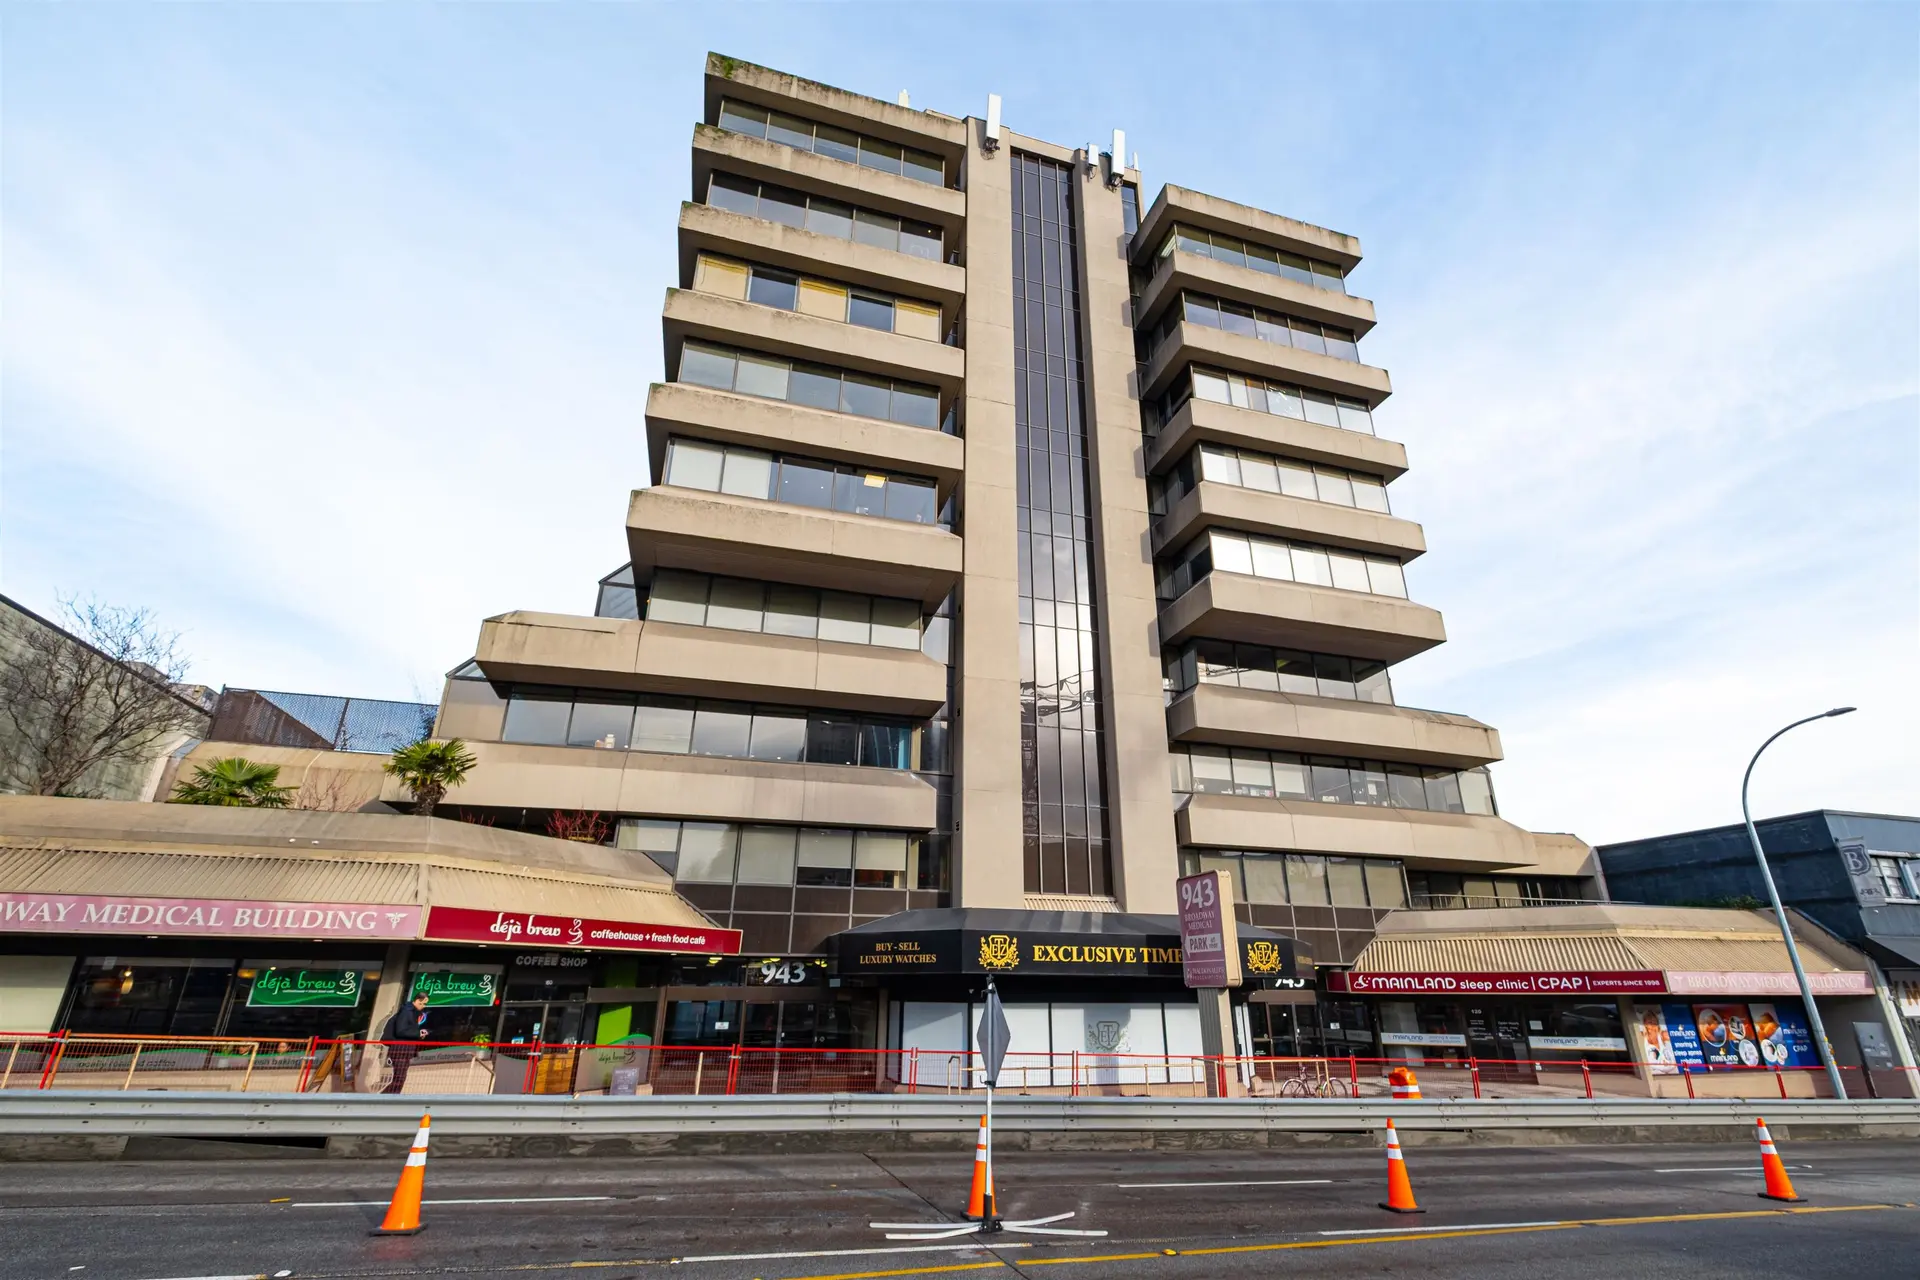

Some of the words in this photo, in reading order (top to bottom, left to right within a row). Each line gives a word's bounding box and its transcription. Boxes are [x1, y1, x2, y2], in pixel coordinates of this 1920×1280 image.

[1843, 851, 1863, 871] B
[1182, 879, 1215, 910] 943
[0, 901, 76, 923] WAY
[80, 903, 224, 927] MEDICAL
[232, 907, 378, 931] BUILDING
[1185, 912, 1215, 922] BROADWAY
[490, 912, 522, 941] déjà
[527, 914, 561, 937] brew
[590, 929, 644, 942] coffeehouse
[651, 932, 672, 944] fresh
[672, 933, 689, 945] food
[875, 942, 893, 952] BUY
[898, 942, 921, 951] SELL
[1189, 936, 1208, 951] PARK
[515, 955, 559, 966] COFFEE
[560, 956, 588, 967] SHOP
[859, 954, 893, 965] LUXURY
[894, 953, 937, 964] WATCHES
[1032, 945, 1137, 963] EXCLUSIVE
[761, 961, 806, 984] 943
[257, 970, 291, 995] déjà
[297, 971, 336, 989] brew
[415, 972, 442, 996] déjà
[447, 973, 477, 991] brew
[1371, 977, 1456, 989] MAINLAND
[1460, 979, 1493, 991] sleep
[1496, 979, 1529, 990] clinic
[1538, 977, 1583, 989] CPAP
[1688, 975, 1750, 989] BROADWAY
[1754, 976, 1799, 989] MEDICA
